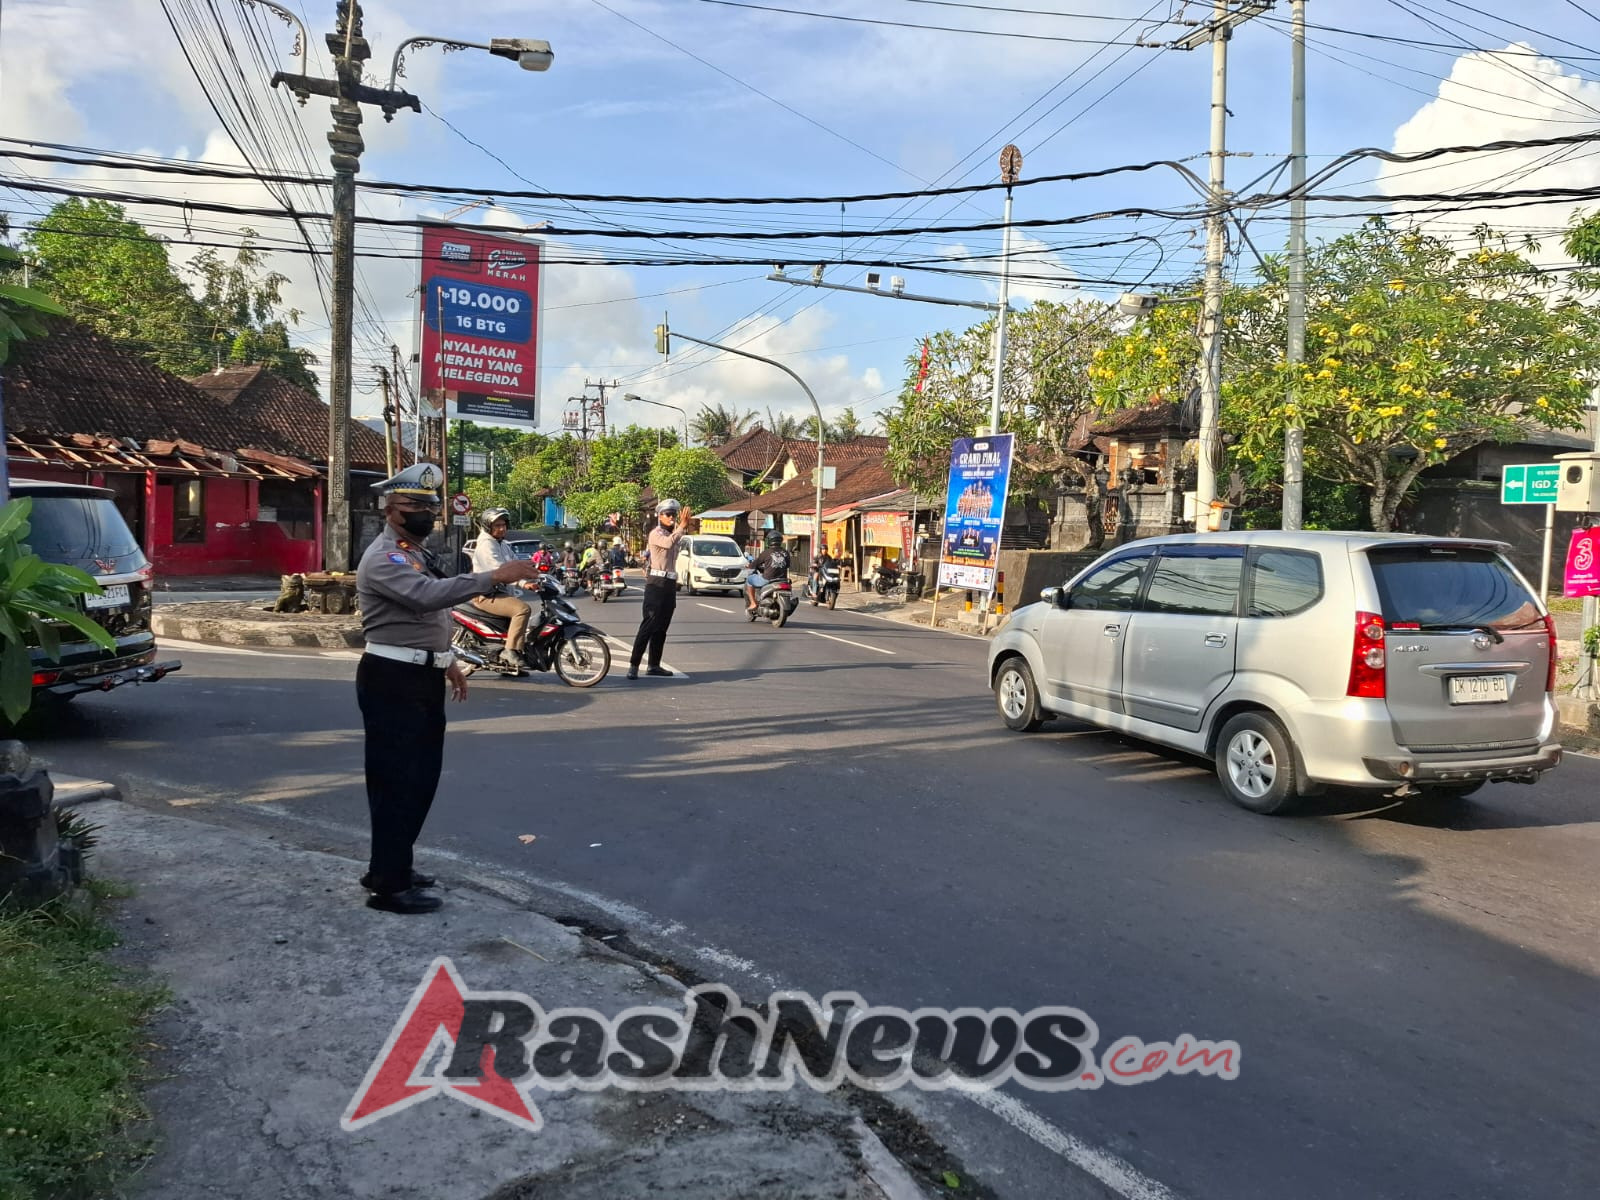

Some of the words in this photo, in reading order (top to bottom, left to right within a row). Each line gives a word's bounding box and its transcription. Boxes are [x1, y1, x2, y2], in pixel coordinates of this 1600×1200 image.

[487, 269, 526, 282] MERAH
[456, 316, 472, 328] 16
[476, 319, 506, 333] BTG
[443, 340, 517, 359] NYALAKAN
[434, 353, 483, 368] MERAH
[487, 360, 523, 374] YANG
[437, 367, 519, 387] MELEGENDA
[960, 453, 981, 465] GRAND
[982, 452, 1000, 465] FINAL
[1531, 480, 1551, 489] IGD
[1455, 677, 1466, 693] DK
[1468, 677, 1489, 693] 1270
[1493, 677, 1505, 692] BD
